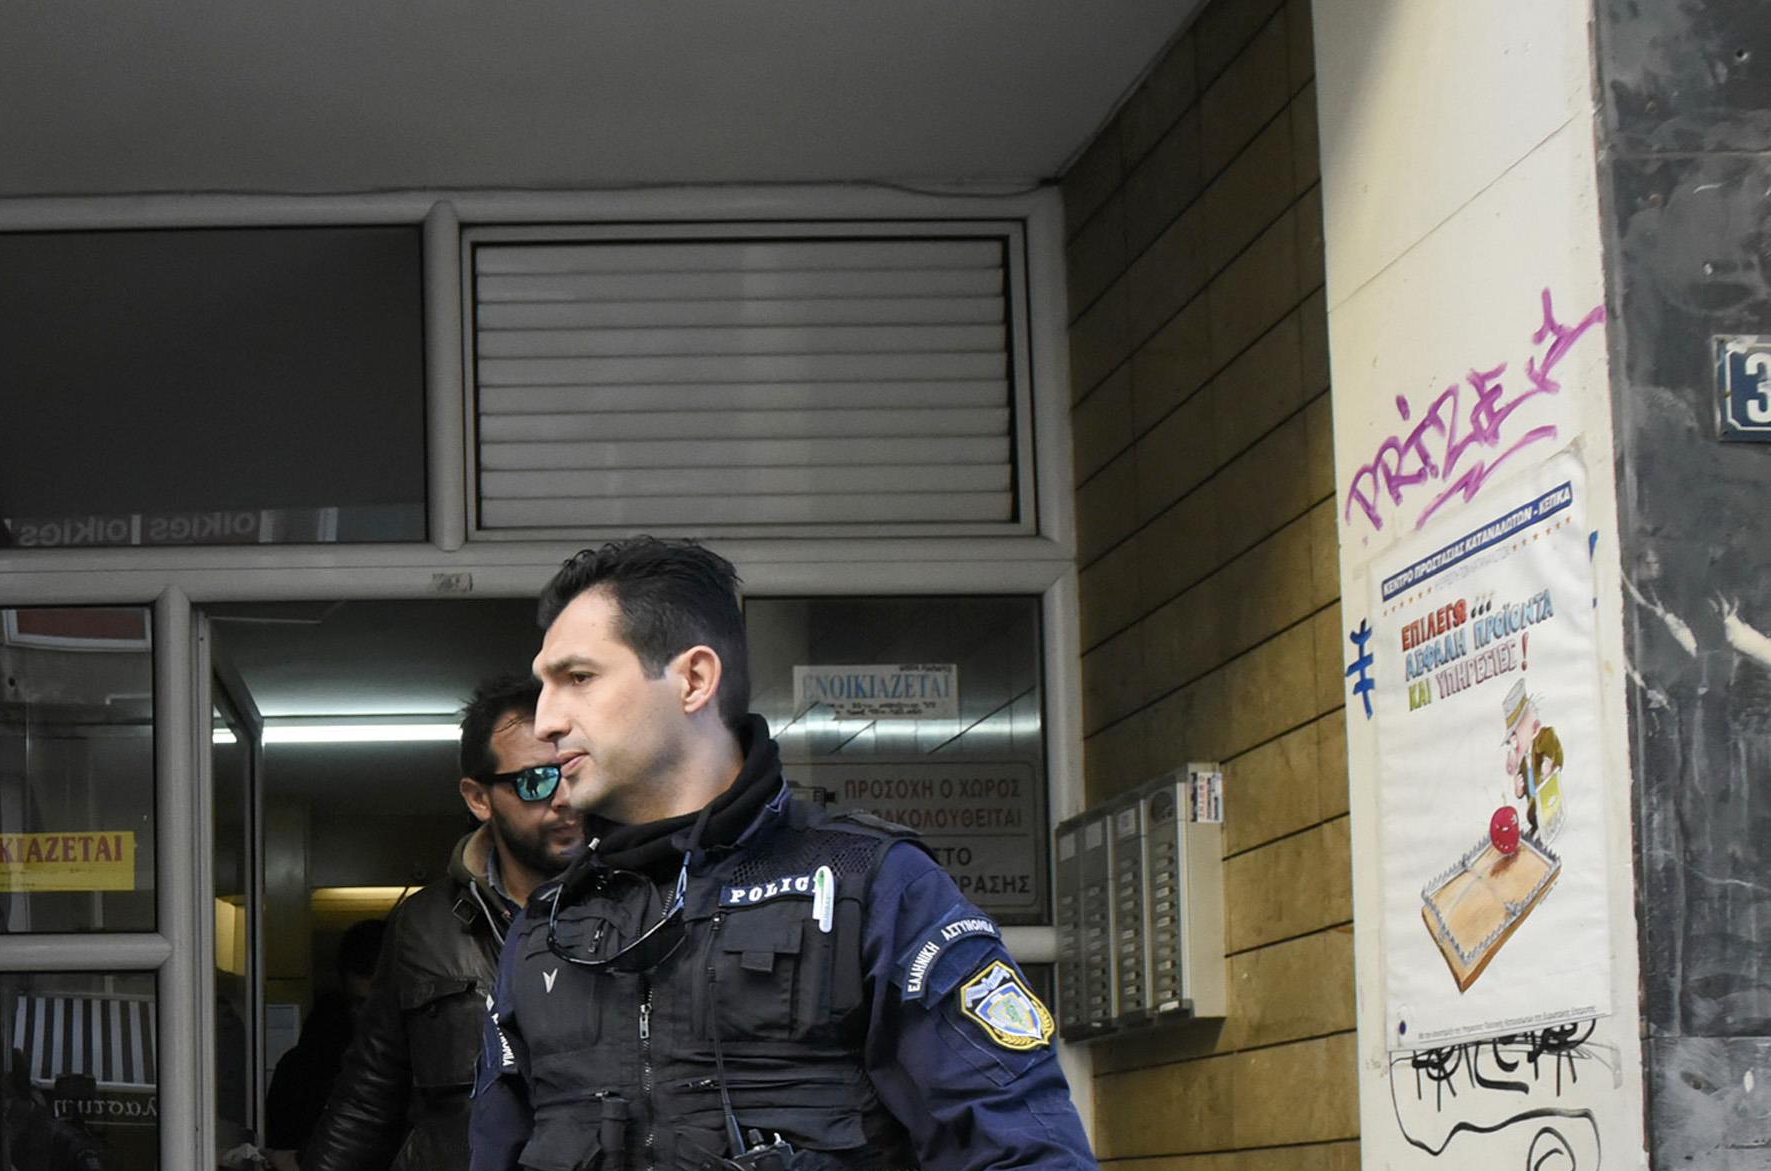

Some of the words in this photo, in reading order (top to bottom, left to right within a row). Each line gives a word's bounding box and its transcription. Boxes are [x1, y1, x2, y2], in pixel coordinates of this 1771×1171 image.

[802, 674, 951, 699] ΕΝΟΙΚΙΑΖΕΤΑΙ
[1409, 679, 1432, 711] ΚΑΙ
[845, 779, 934, 799] ΠΡΟΣΟΧΗ
[940, 779, 953, 799] Ο
[960, 779, 1021, 799] ΧΩΡΟΣ
[908, 941, 940, 992] ΕΛΛΗΝΙΚΗ
